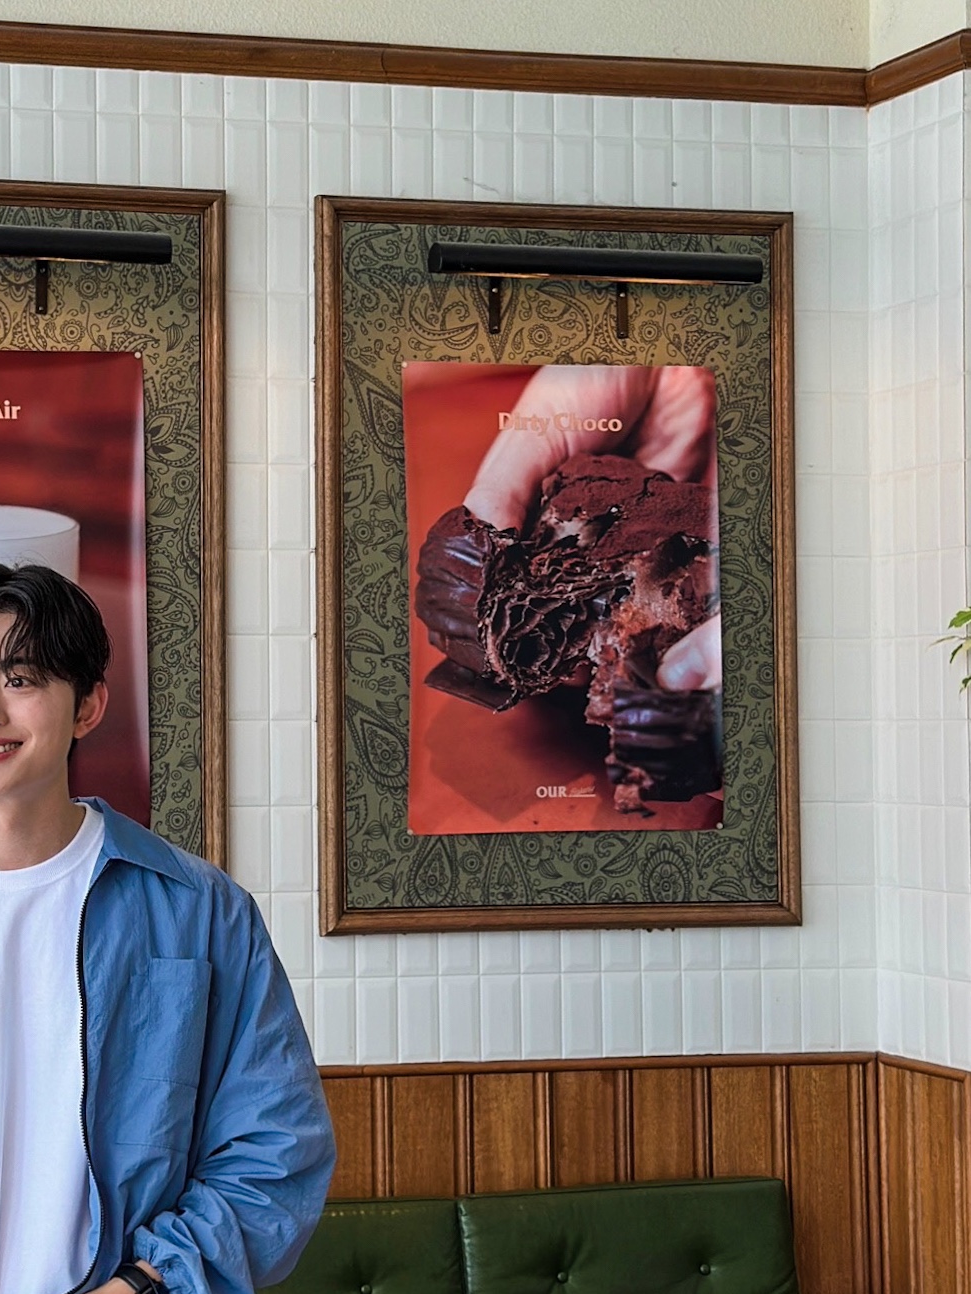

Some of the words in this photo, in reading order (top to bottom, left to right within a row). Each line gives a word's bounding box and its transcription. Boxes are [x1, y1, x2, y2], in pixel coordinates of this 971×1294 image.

[498, 411, 548, 436] Dirty
[553, 412, 623, 432] Choco
[536, 785, 567, 798] OUR
